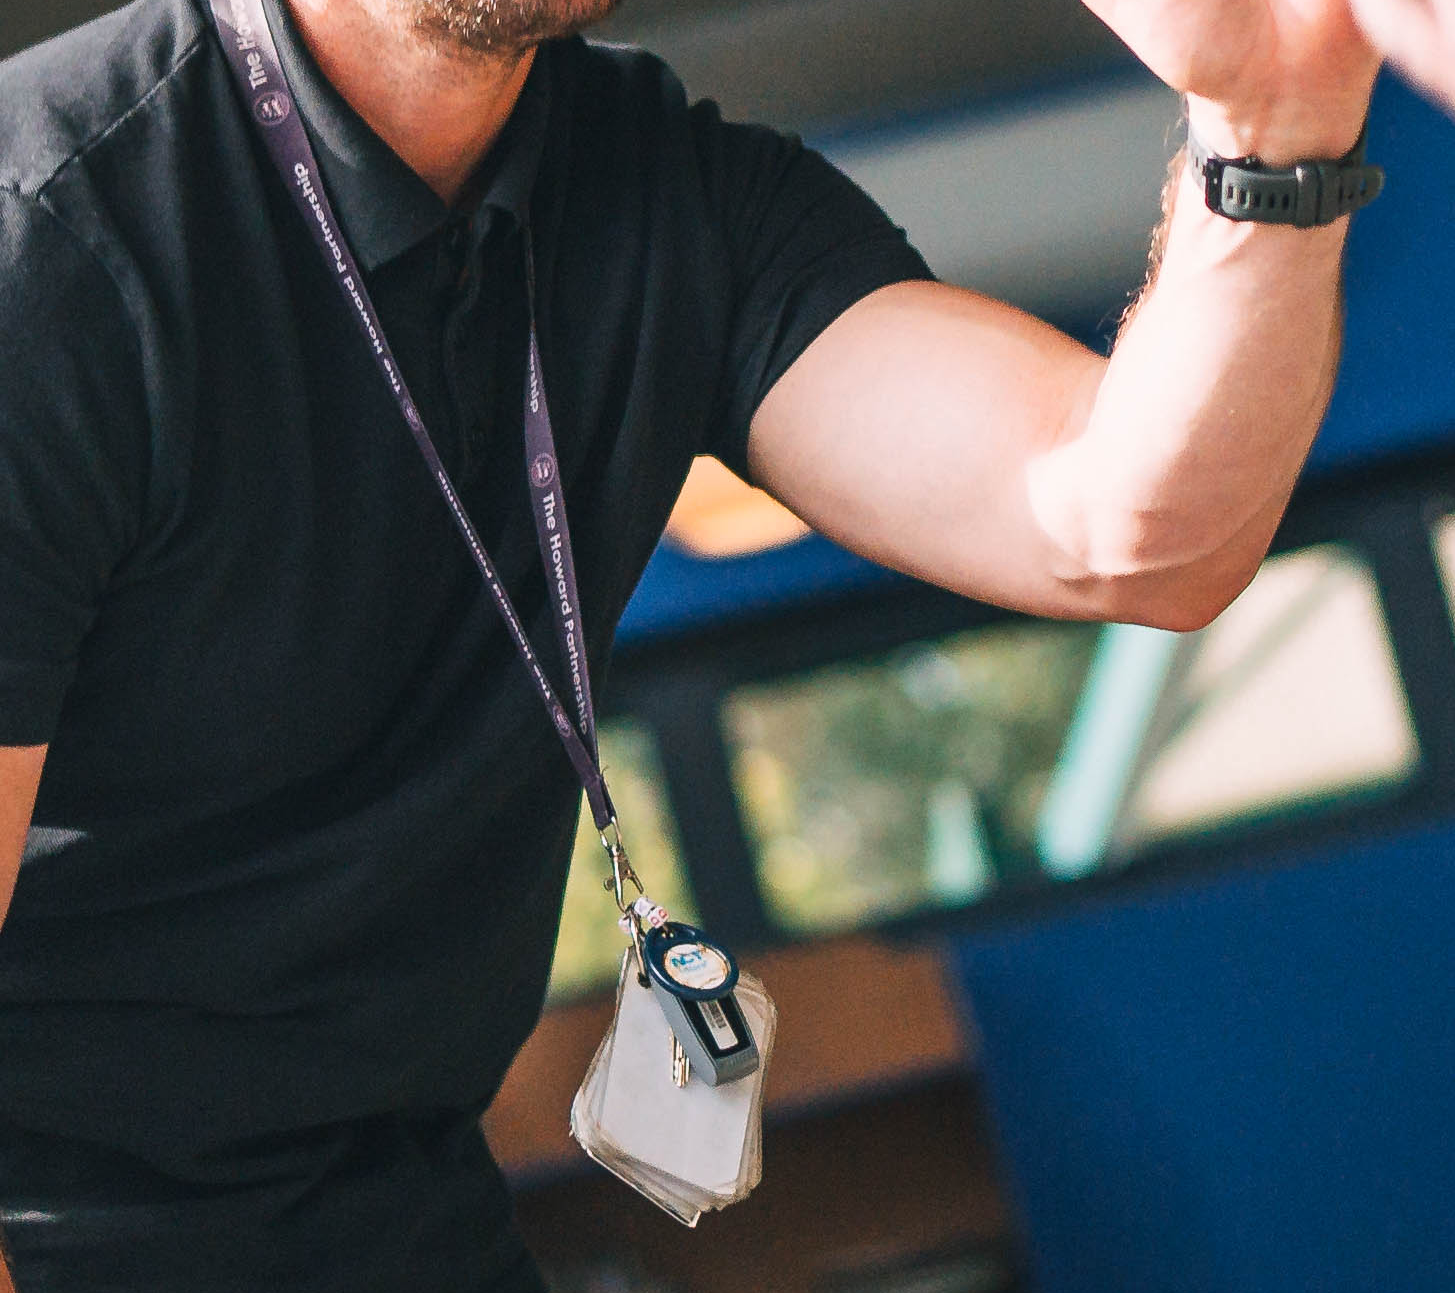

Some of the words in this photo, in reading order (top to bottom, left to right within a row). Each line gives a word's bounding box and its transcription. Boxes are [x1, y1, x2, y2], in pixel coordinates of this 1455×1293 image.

[246, 51, 269, 90] The
[294, 161, 348, 274] Partnership
[344, 275, 384, 355] Howard
[383, 358, 402, 395] The
[542, 491, 557, 531] The
[549, 532, 573, 616] Howard
[564, 618, 588, 736] Partnership
